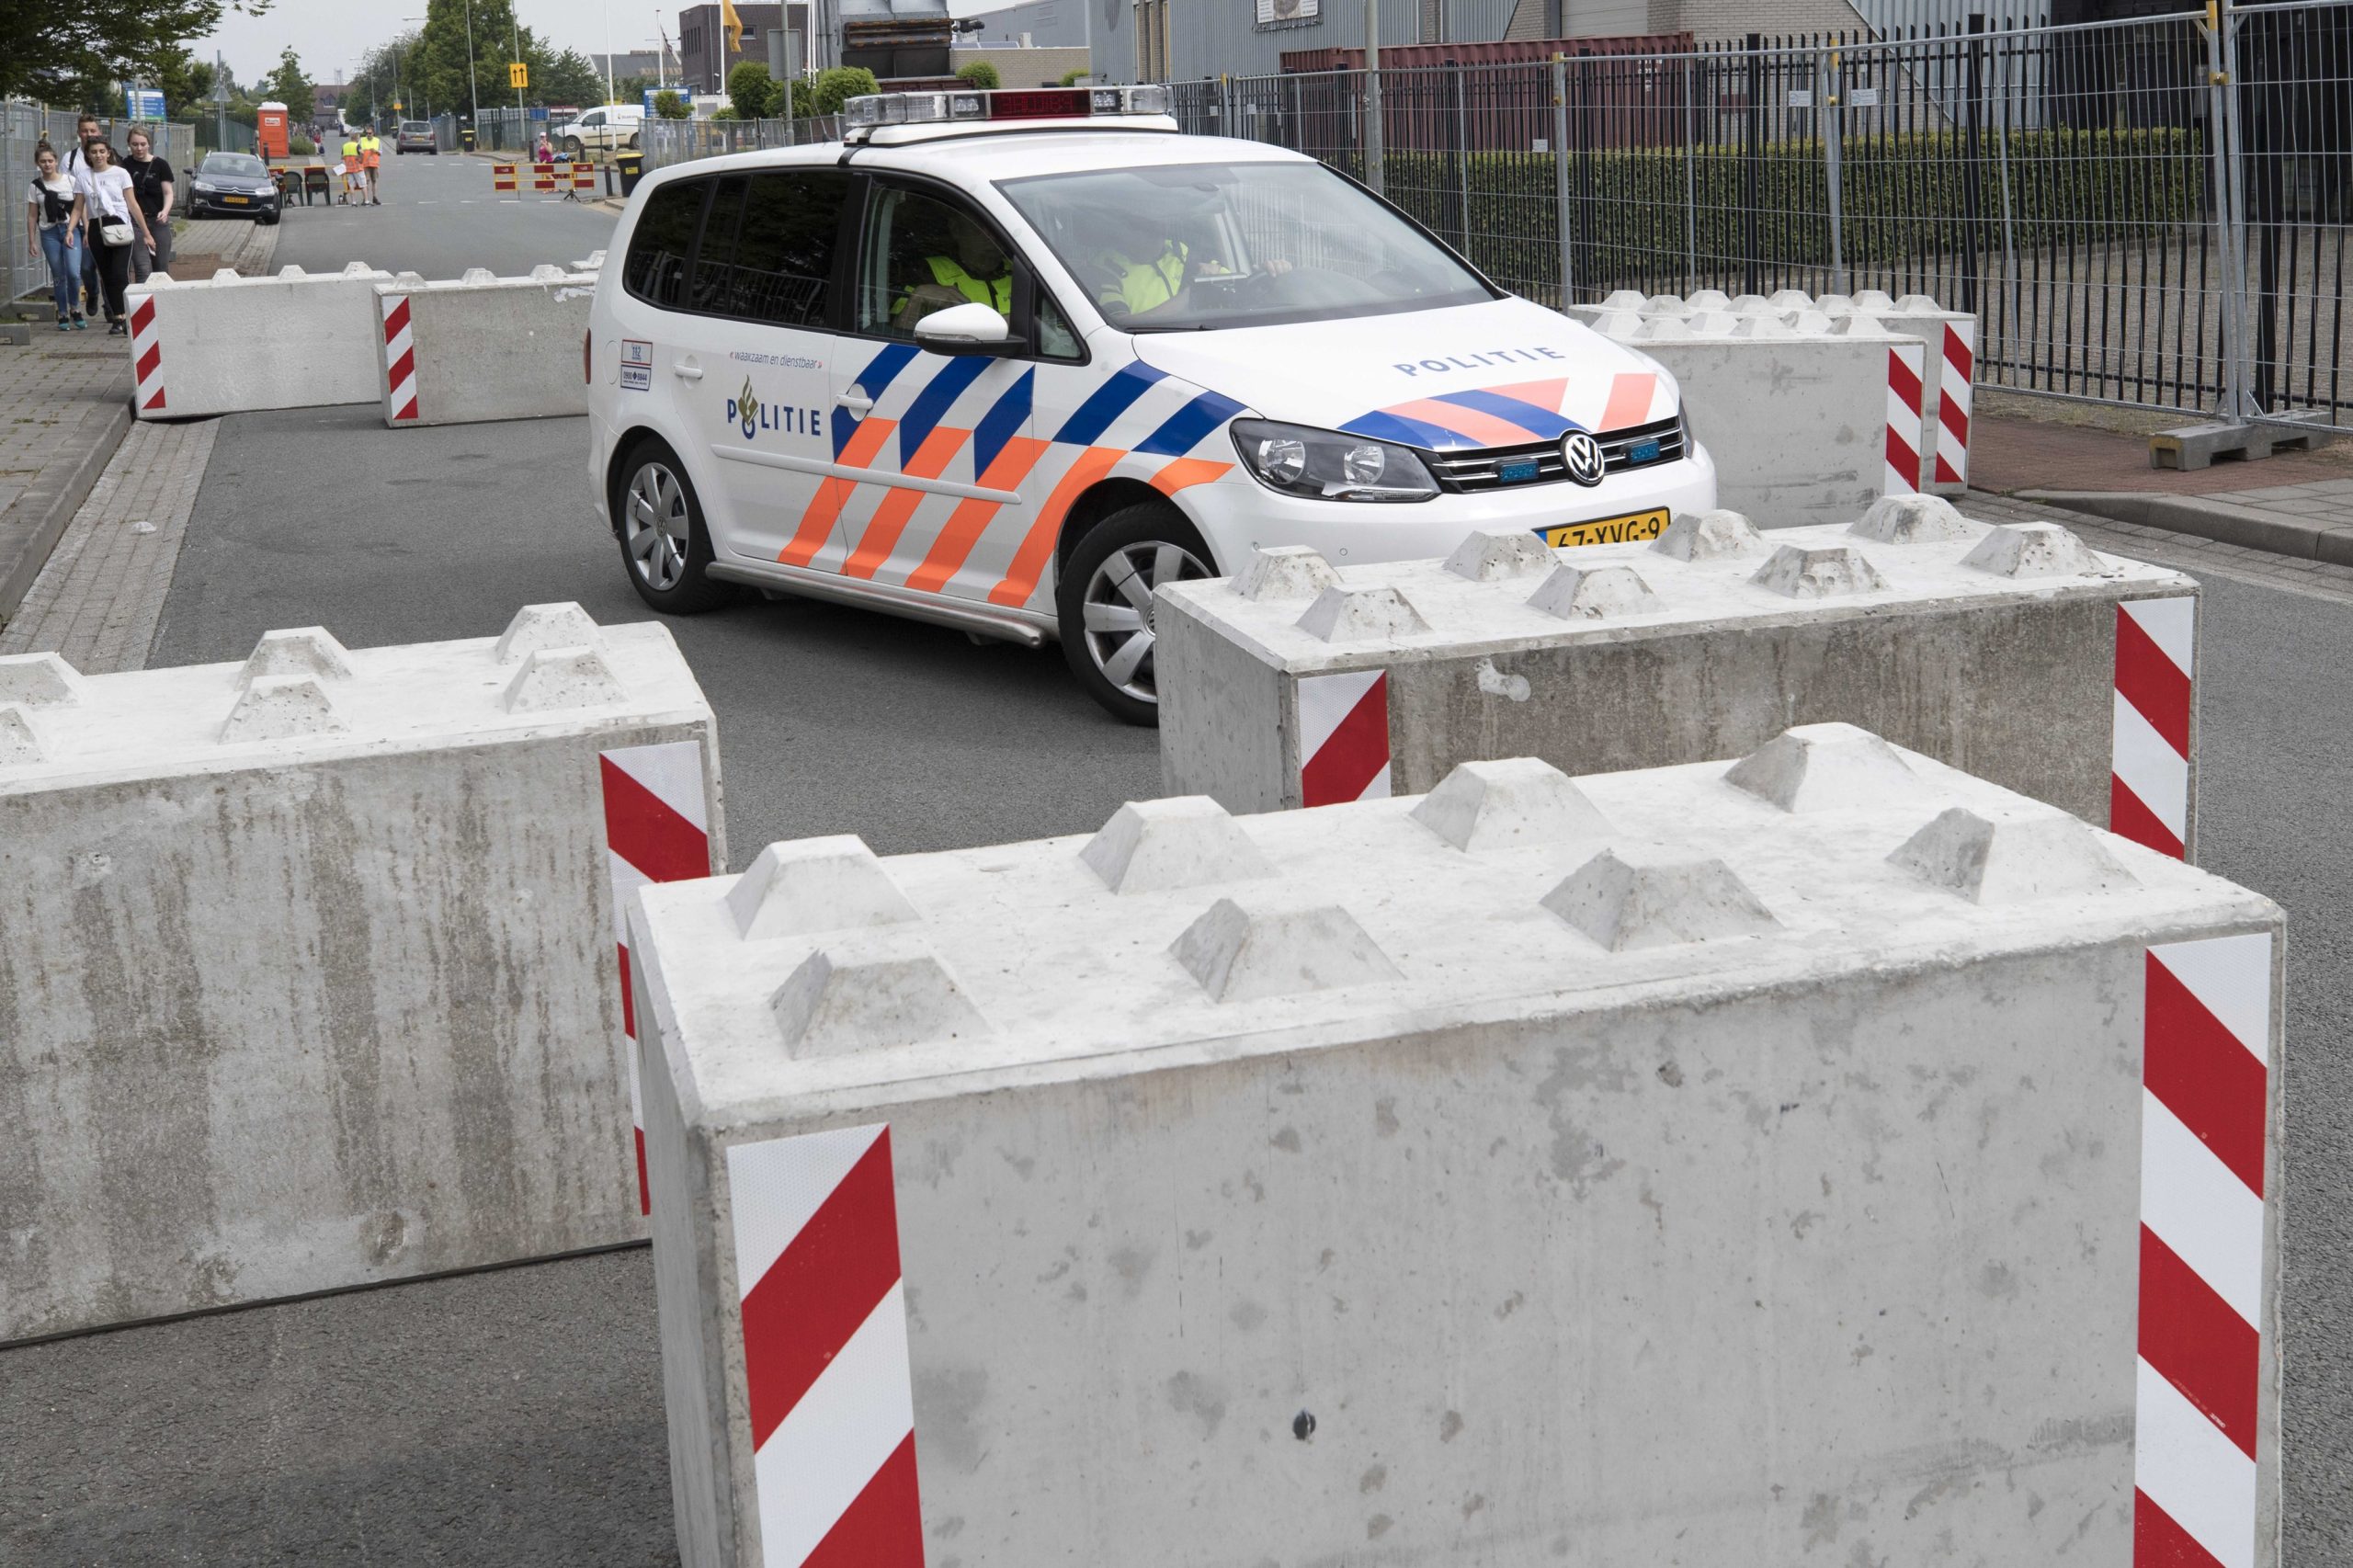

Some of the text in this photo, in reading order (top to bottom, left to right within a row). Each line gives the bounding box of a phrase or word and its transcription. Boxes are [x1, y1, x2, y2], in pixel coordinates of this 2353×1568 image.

[631, 346, 642, 357] 112
[734, 351, 769, 364] waakzaam
[770, 356, 779, 365] en
[780, 356, 817, 369] dienstbaar
[1392, 347, 1566, 376] POLITIE
[727, 398, 822, 439] POLITIE
[1558, 517, 1660, 548] 67-XVG-9
